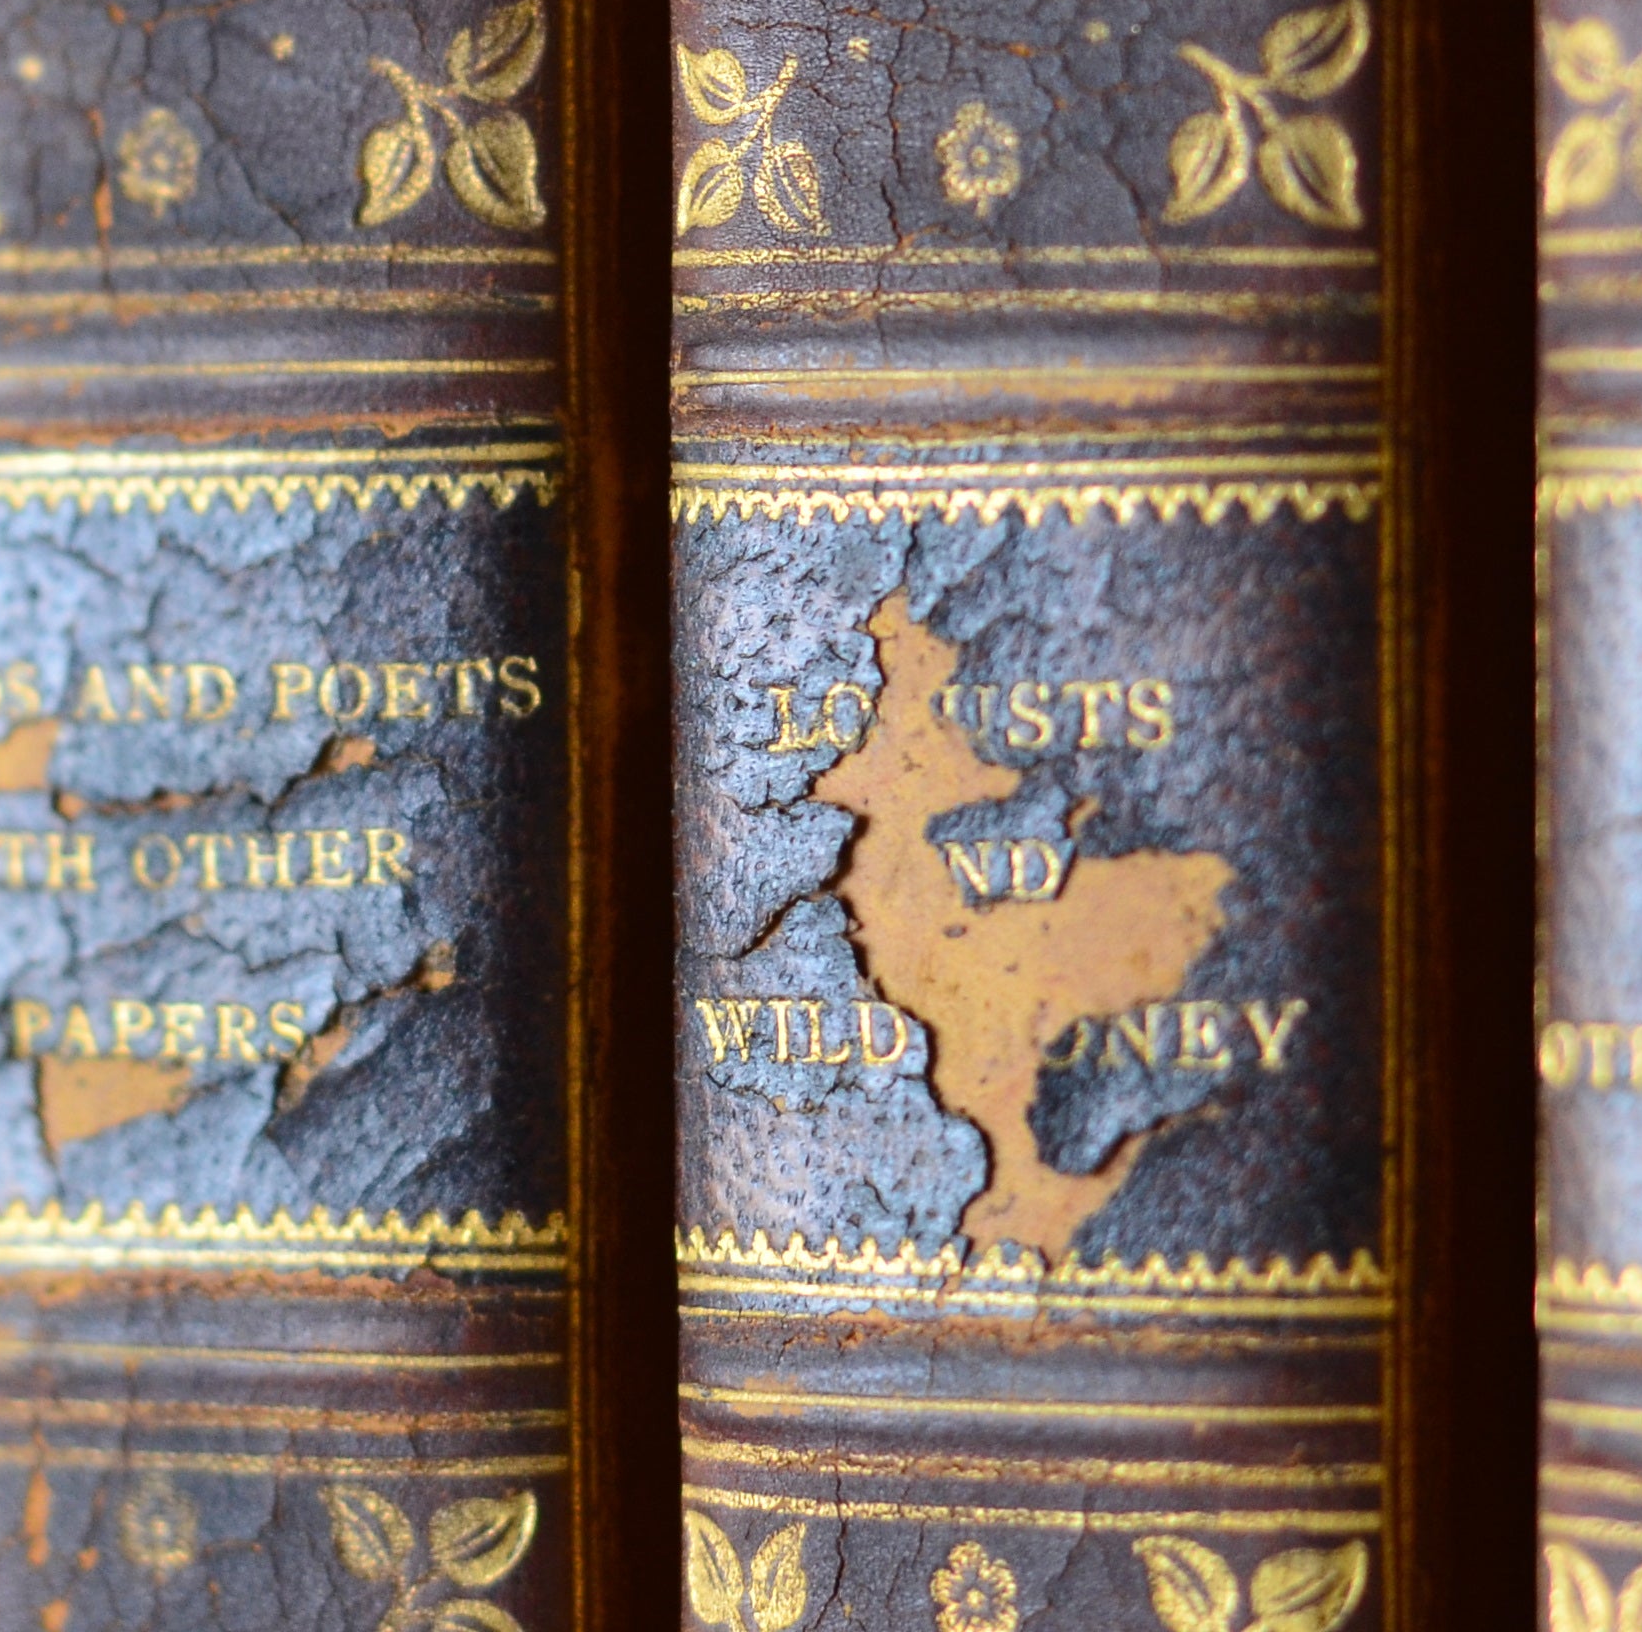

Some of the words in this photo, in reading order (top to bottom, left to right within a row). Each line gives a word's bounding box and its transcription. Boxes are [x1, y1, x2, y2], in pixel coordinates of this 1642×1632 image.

[73, 662, 238, 722] AND
[272, 654, 542, 722] POETS
[765, 676, 1177, 754] LOUSTS
[130, 828, 414, 892] OTHER
[942, 838, 1065, 902] ND
[9, 998, 309, 1062] PAPERS
[693, 996, 909, 1069] WILD
